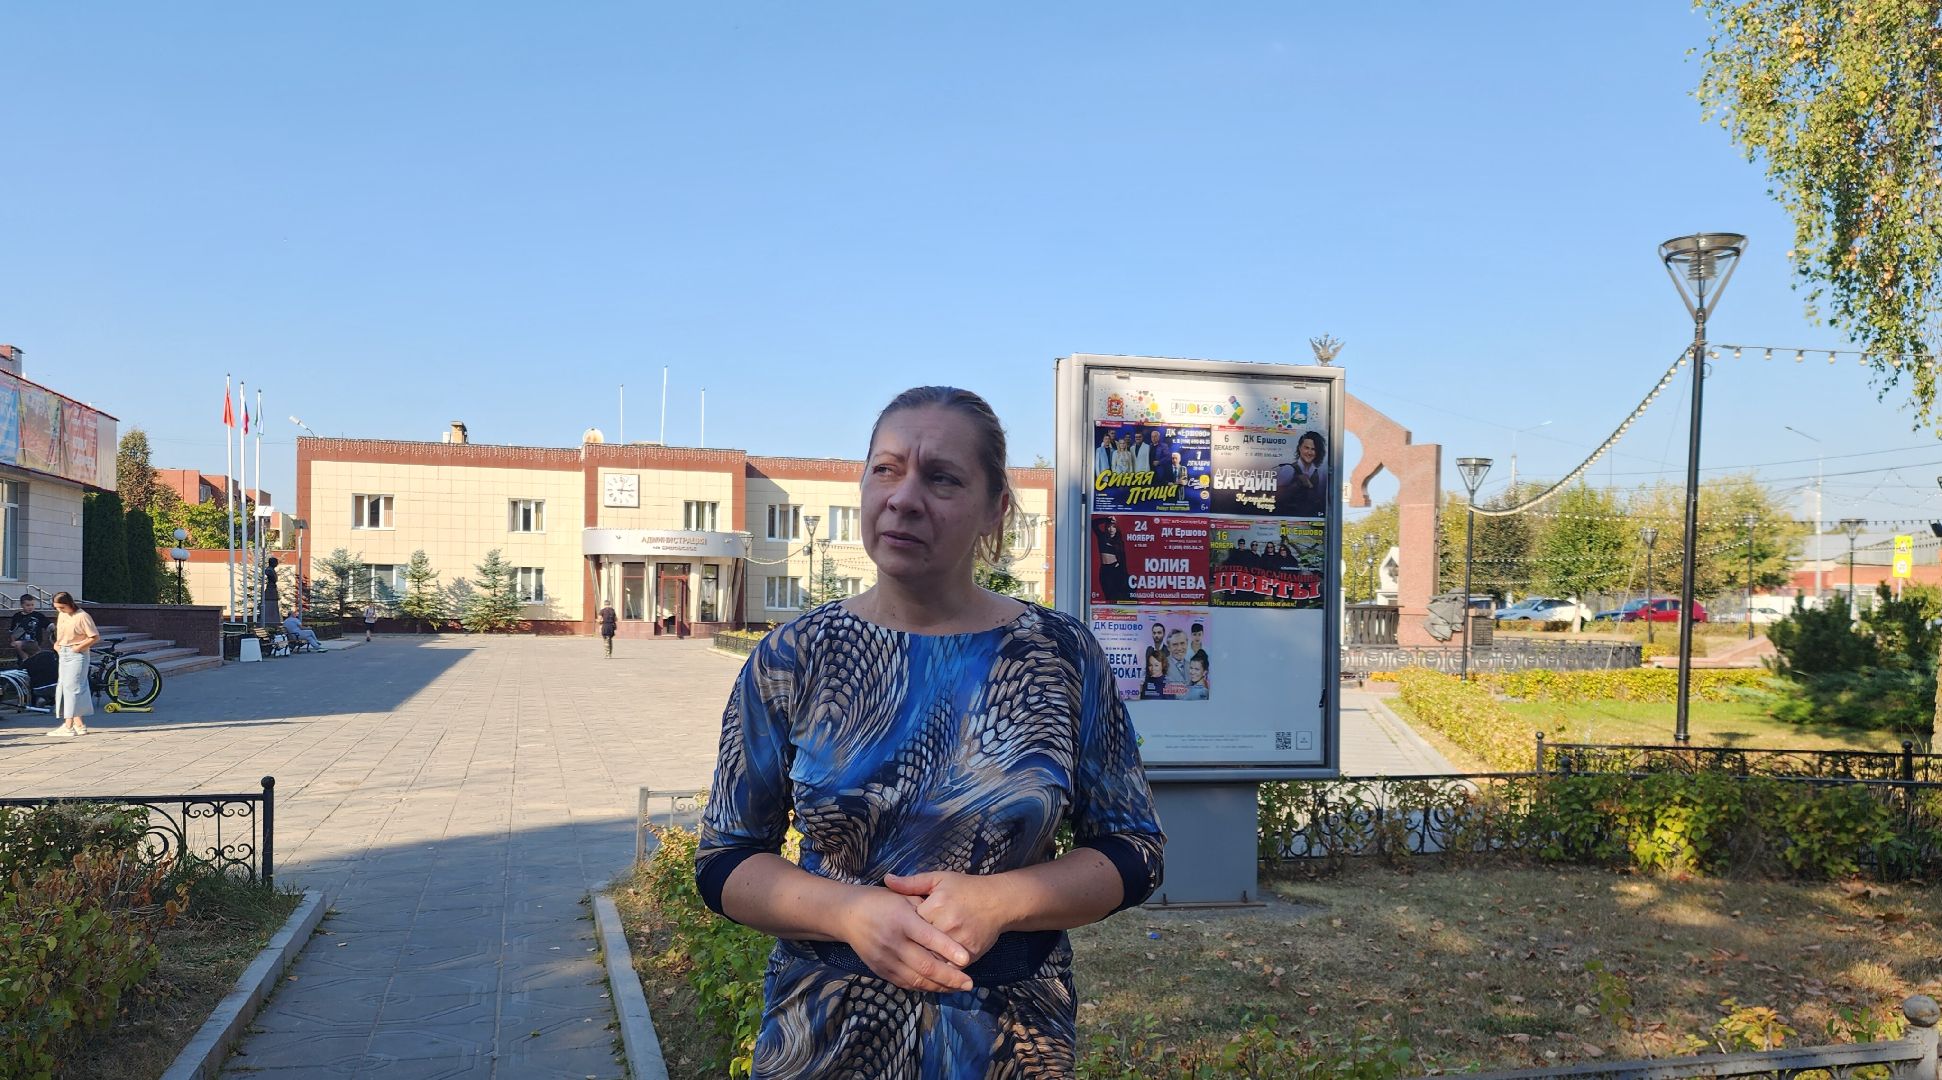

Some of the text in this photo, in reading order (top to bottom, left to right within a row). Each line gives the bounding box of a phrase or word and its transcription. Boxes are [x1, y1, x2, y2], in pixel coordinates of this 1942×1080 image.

[1165, 428, 1176, 437] ДК
[1224, 435, 1230, 443] 6
[1243, 435, 1287, 445] ДК Ершово
[1215, 468, 1277, 479] АЛЕКСАНДР
[1213, 477, 1277, 493] БАРДИН
[1134, 521, 1148, 532] 24
[1280, 527, 1292, 536] ДК
[1294, 528, 1324, 536] Ершово
[1162, 528, 1207, 538] ДК Ершово
[1217, 531, 1228, 540] 16
[642, 536, 708, 545] АДМИНИСТРАЦИЯ
[1144, 558, 1190, 573] ЮЛИЯ
[1128, 575, 1206, 590] САВИЧЕВА
[1212, 572, 1320, 600] ЦВЕТЫ
[1094, 622, 1143, 632] ДК Ершово
[1106, 654, 1138, 665] ВЕСТА
[1112, 668, 1142, 678] РОКАТ
